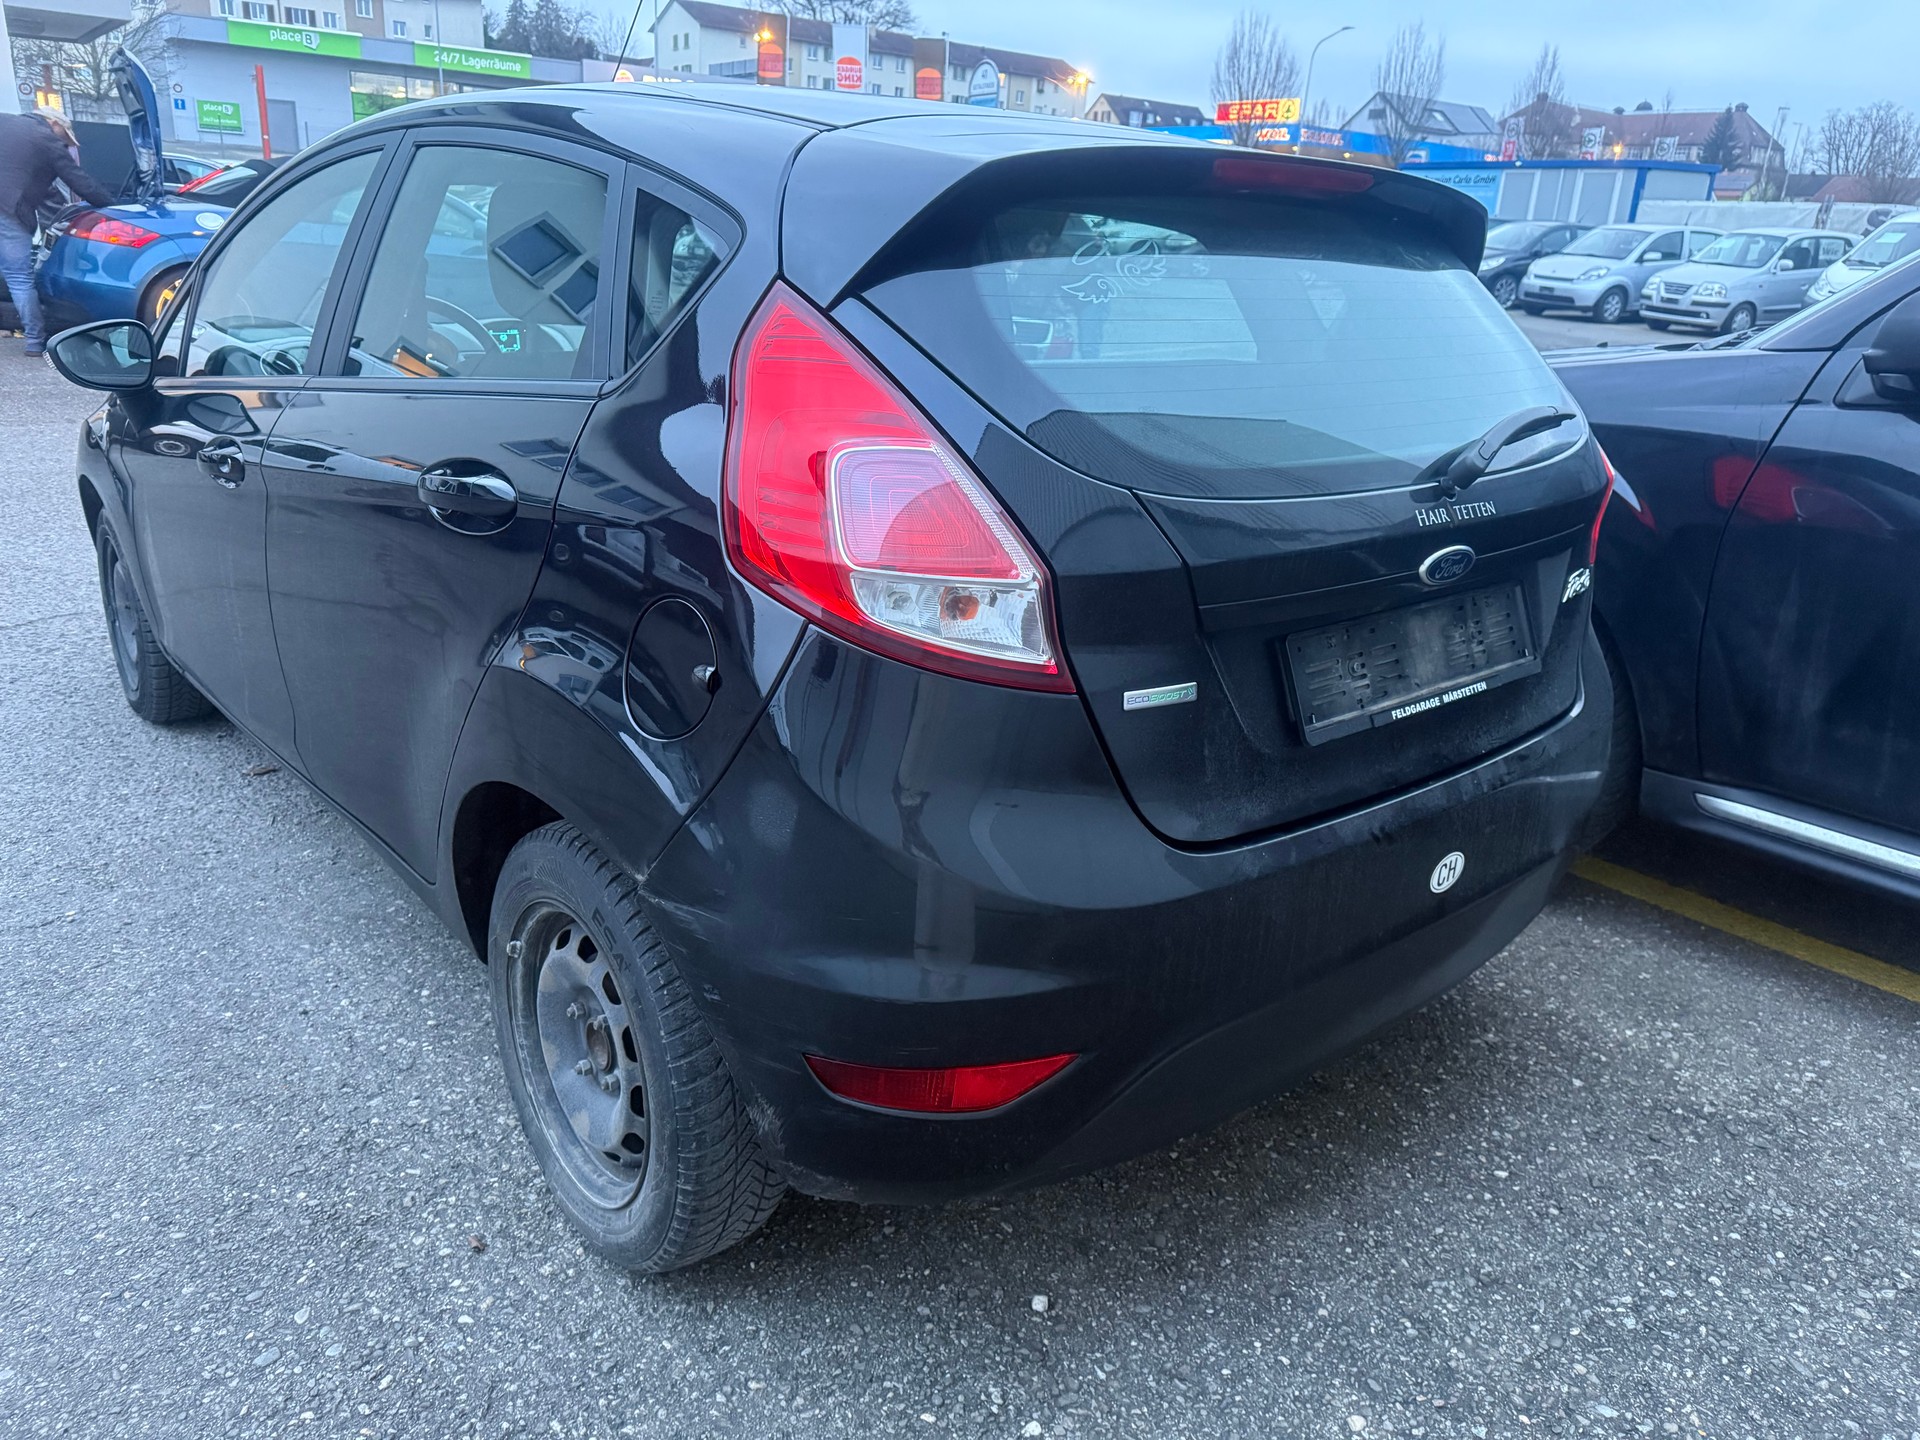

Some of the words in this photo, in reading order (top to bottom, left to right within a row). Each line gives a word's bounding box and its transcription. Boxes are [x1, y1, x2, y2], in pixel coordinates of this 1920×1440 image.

[269, 28, 301, 42] place
[434, 50, 460, 64] 24/7
[462, 54, 522, 72] Lagerräume
[1228, 103, 1278, 120] SPAR
[1415, 508, 1451, 527] HAIR
[1453, 500, 1496, 520] TETTEN
[1434, 555, 1466, 579] Ford
[1391, 696, 1440, 720] FELDGARAGE
[1437, 856, 1459, 887] CH
